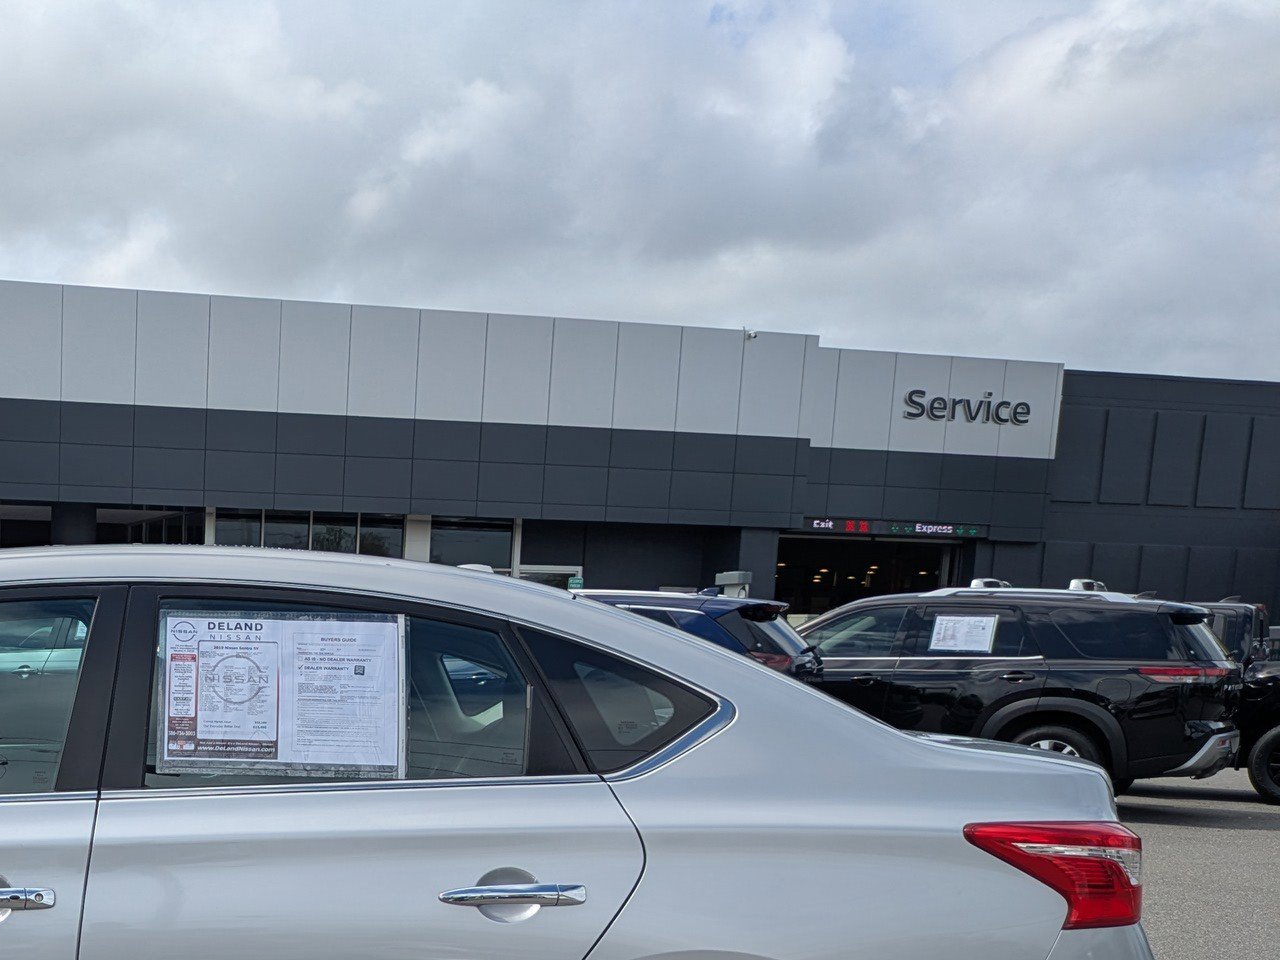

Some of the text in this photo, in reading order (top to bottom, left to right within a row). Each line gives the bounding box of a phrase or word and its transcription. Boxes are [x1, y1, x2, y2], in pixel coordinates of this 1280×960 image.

[903, 389, 1031, 425] Service
[812, 519, 834, 529] Exit
[915, 523, 953, 534] Express
[207, 622, 263, 631] DELAND
[204, 674, 269, 684] NISSAN
